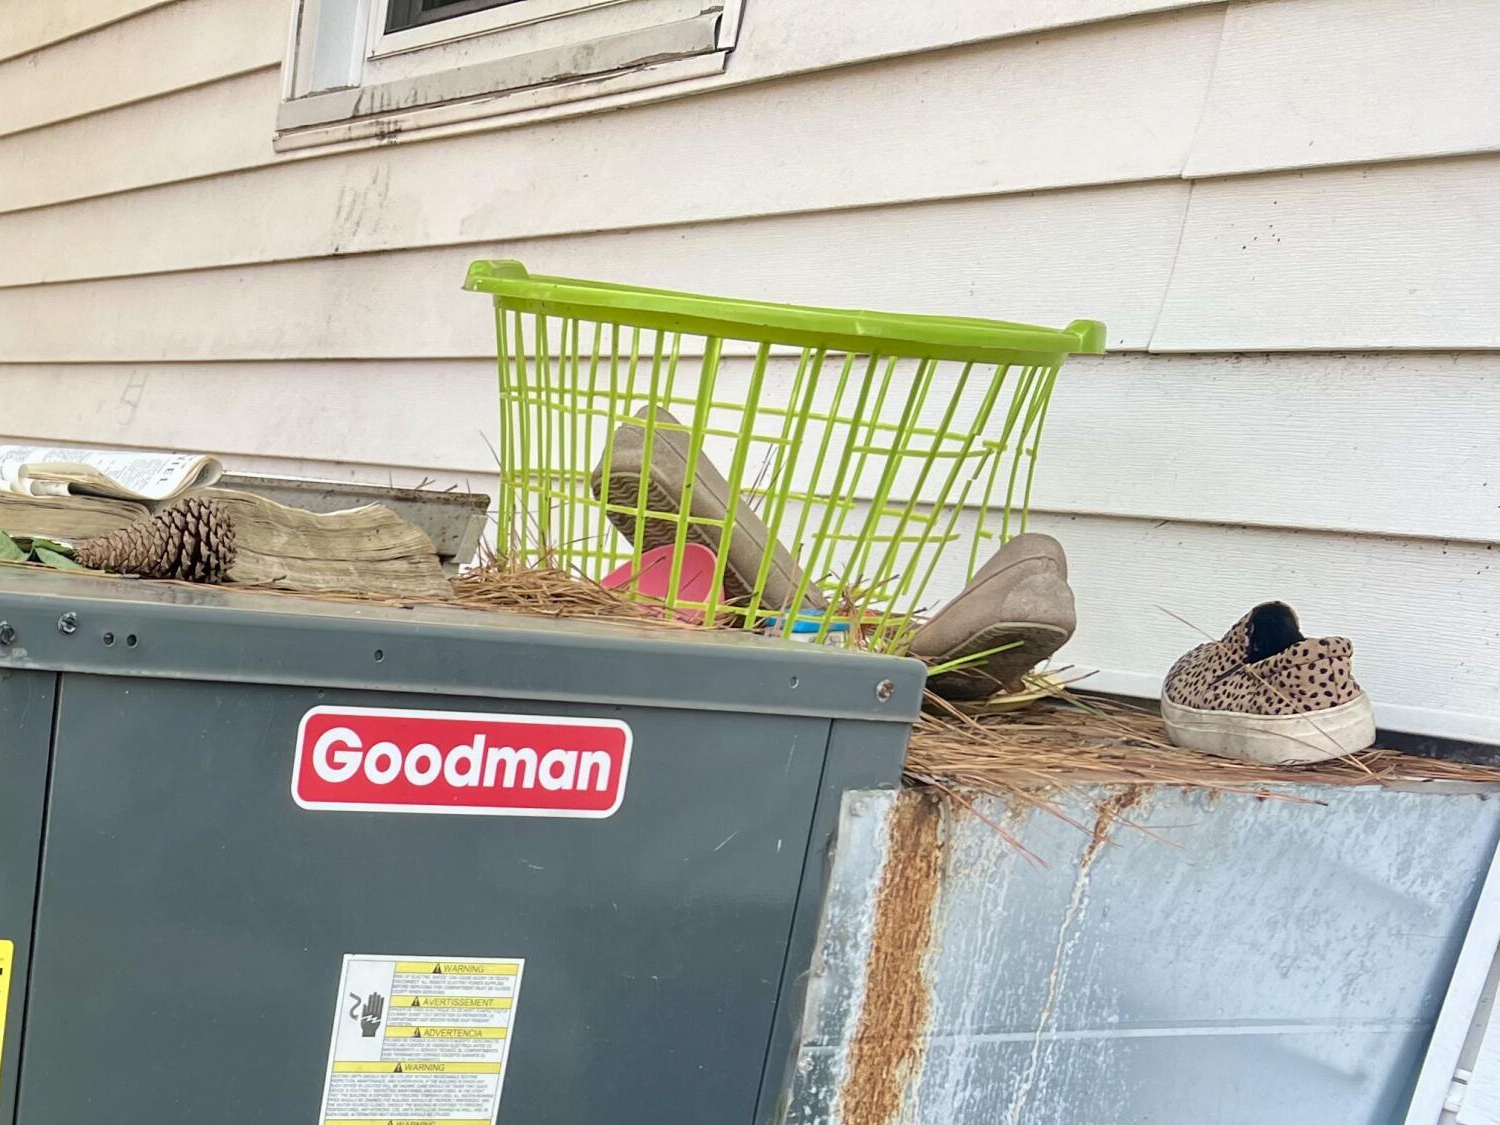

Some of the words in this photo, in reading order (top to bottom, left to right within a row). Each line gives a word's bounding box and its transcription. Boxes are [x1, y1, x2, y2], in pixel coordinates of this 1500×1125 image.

[312, 727, 611, 791] Goodman
[444, 965, 484, 973] WARNING
[423, 998, 494, 1007] AVERTISSEMENT
[424, 1029, 482, 1037] ADVERTENCIA
